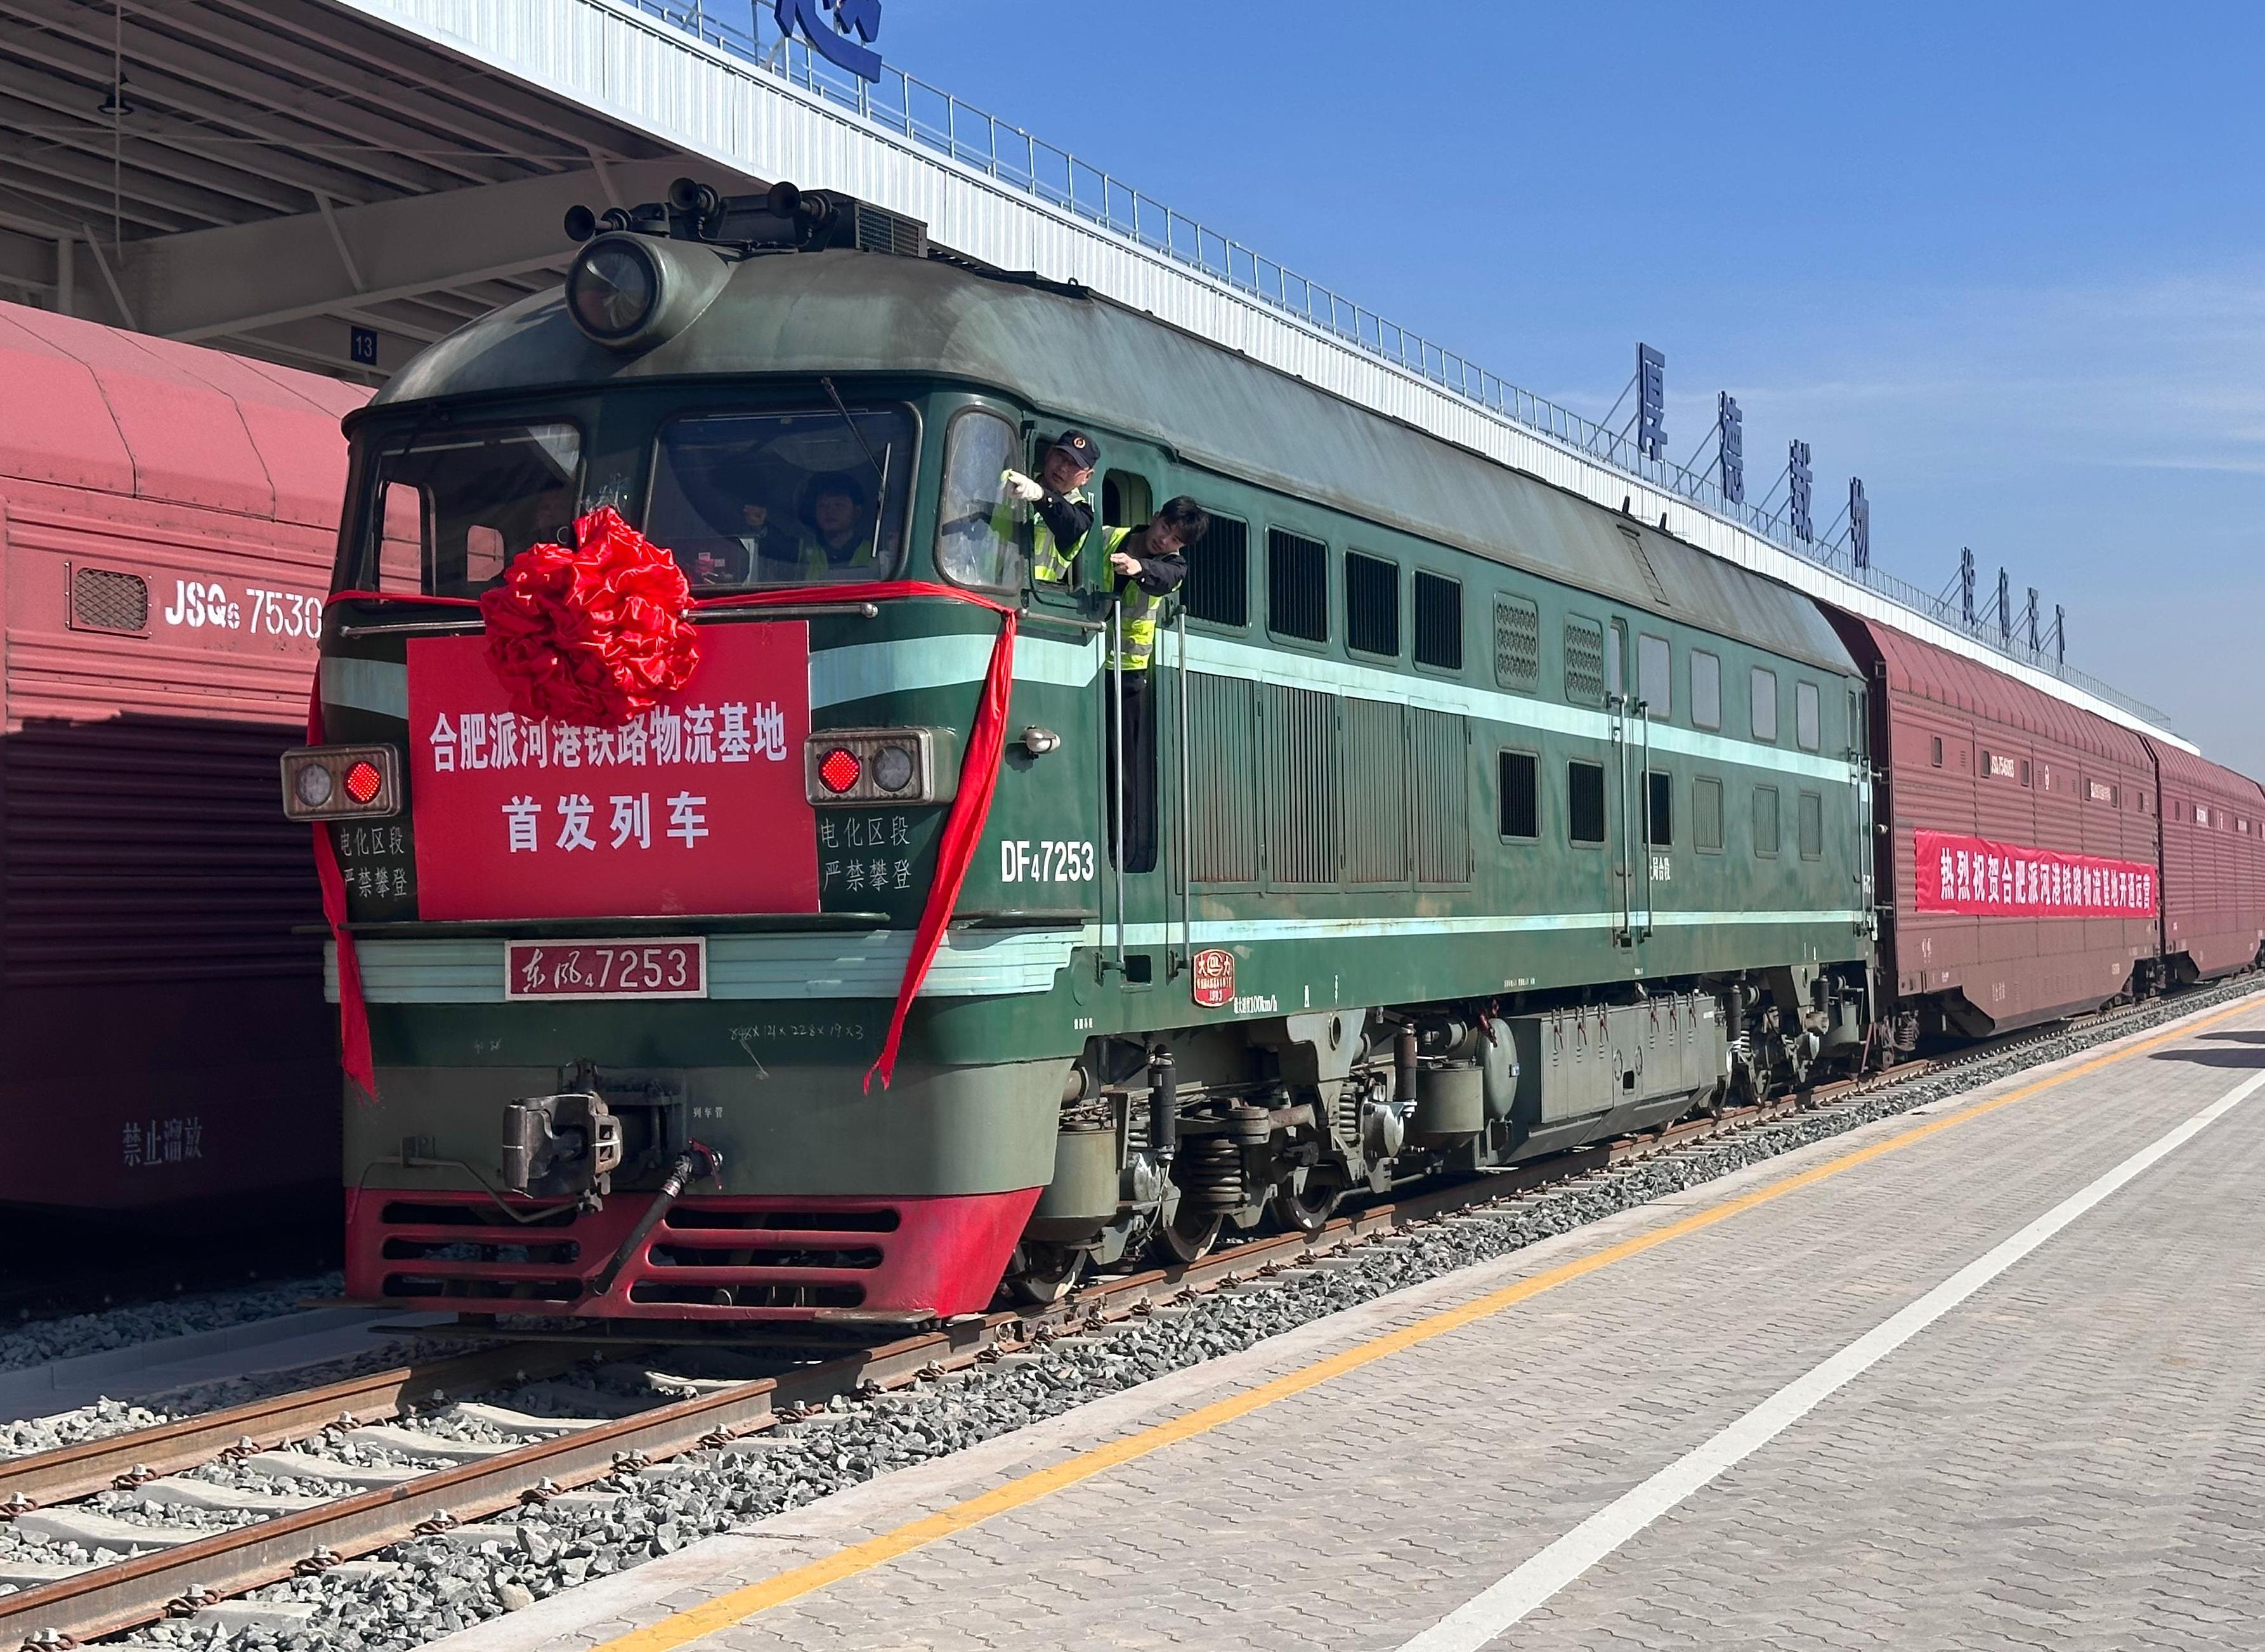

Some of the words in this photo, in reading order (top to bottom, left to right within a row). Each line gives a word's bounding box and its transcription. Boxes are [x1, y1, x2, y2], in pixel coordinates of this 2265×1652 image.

[356, 335, 372, 358] 13
[1636, 342, 1869, 568] 厚德载物
[165, 580, 240, 630] JSQ6
[429, 701, 787, 772] 合肥派河港铁路物流基地
[341, 826, 405, 857] 电化区段
[501, 791, 709, 853] 首发列车
[820, 816, 911, 849] 电化区段
[343, 867, 408, 898] 严禁攀登
[823, 858, 912, 892] 严禁攀登
[1940, 847, 2151, 909] 热烈祝贺合肥派河港铁路物流基地开通运营
[693, 1107, 724, 1119] 列车管
[122, 1117, 203, 1167] 禁止溜放
